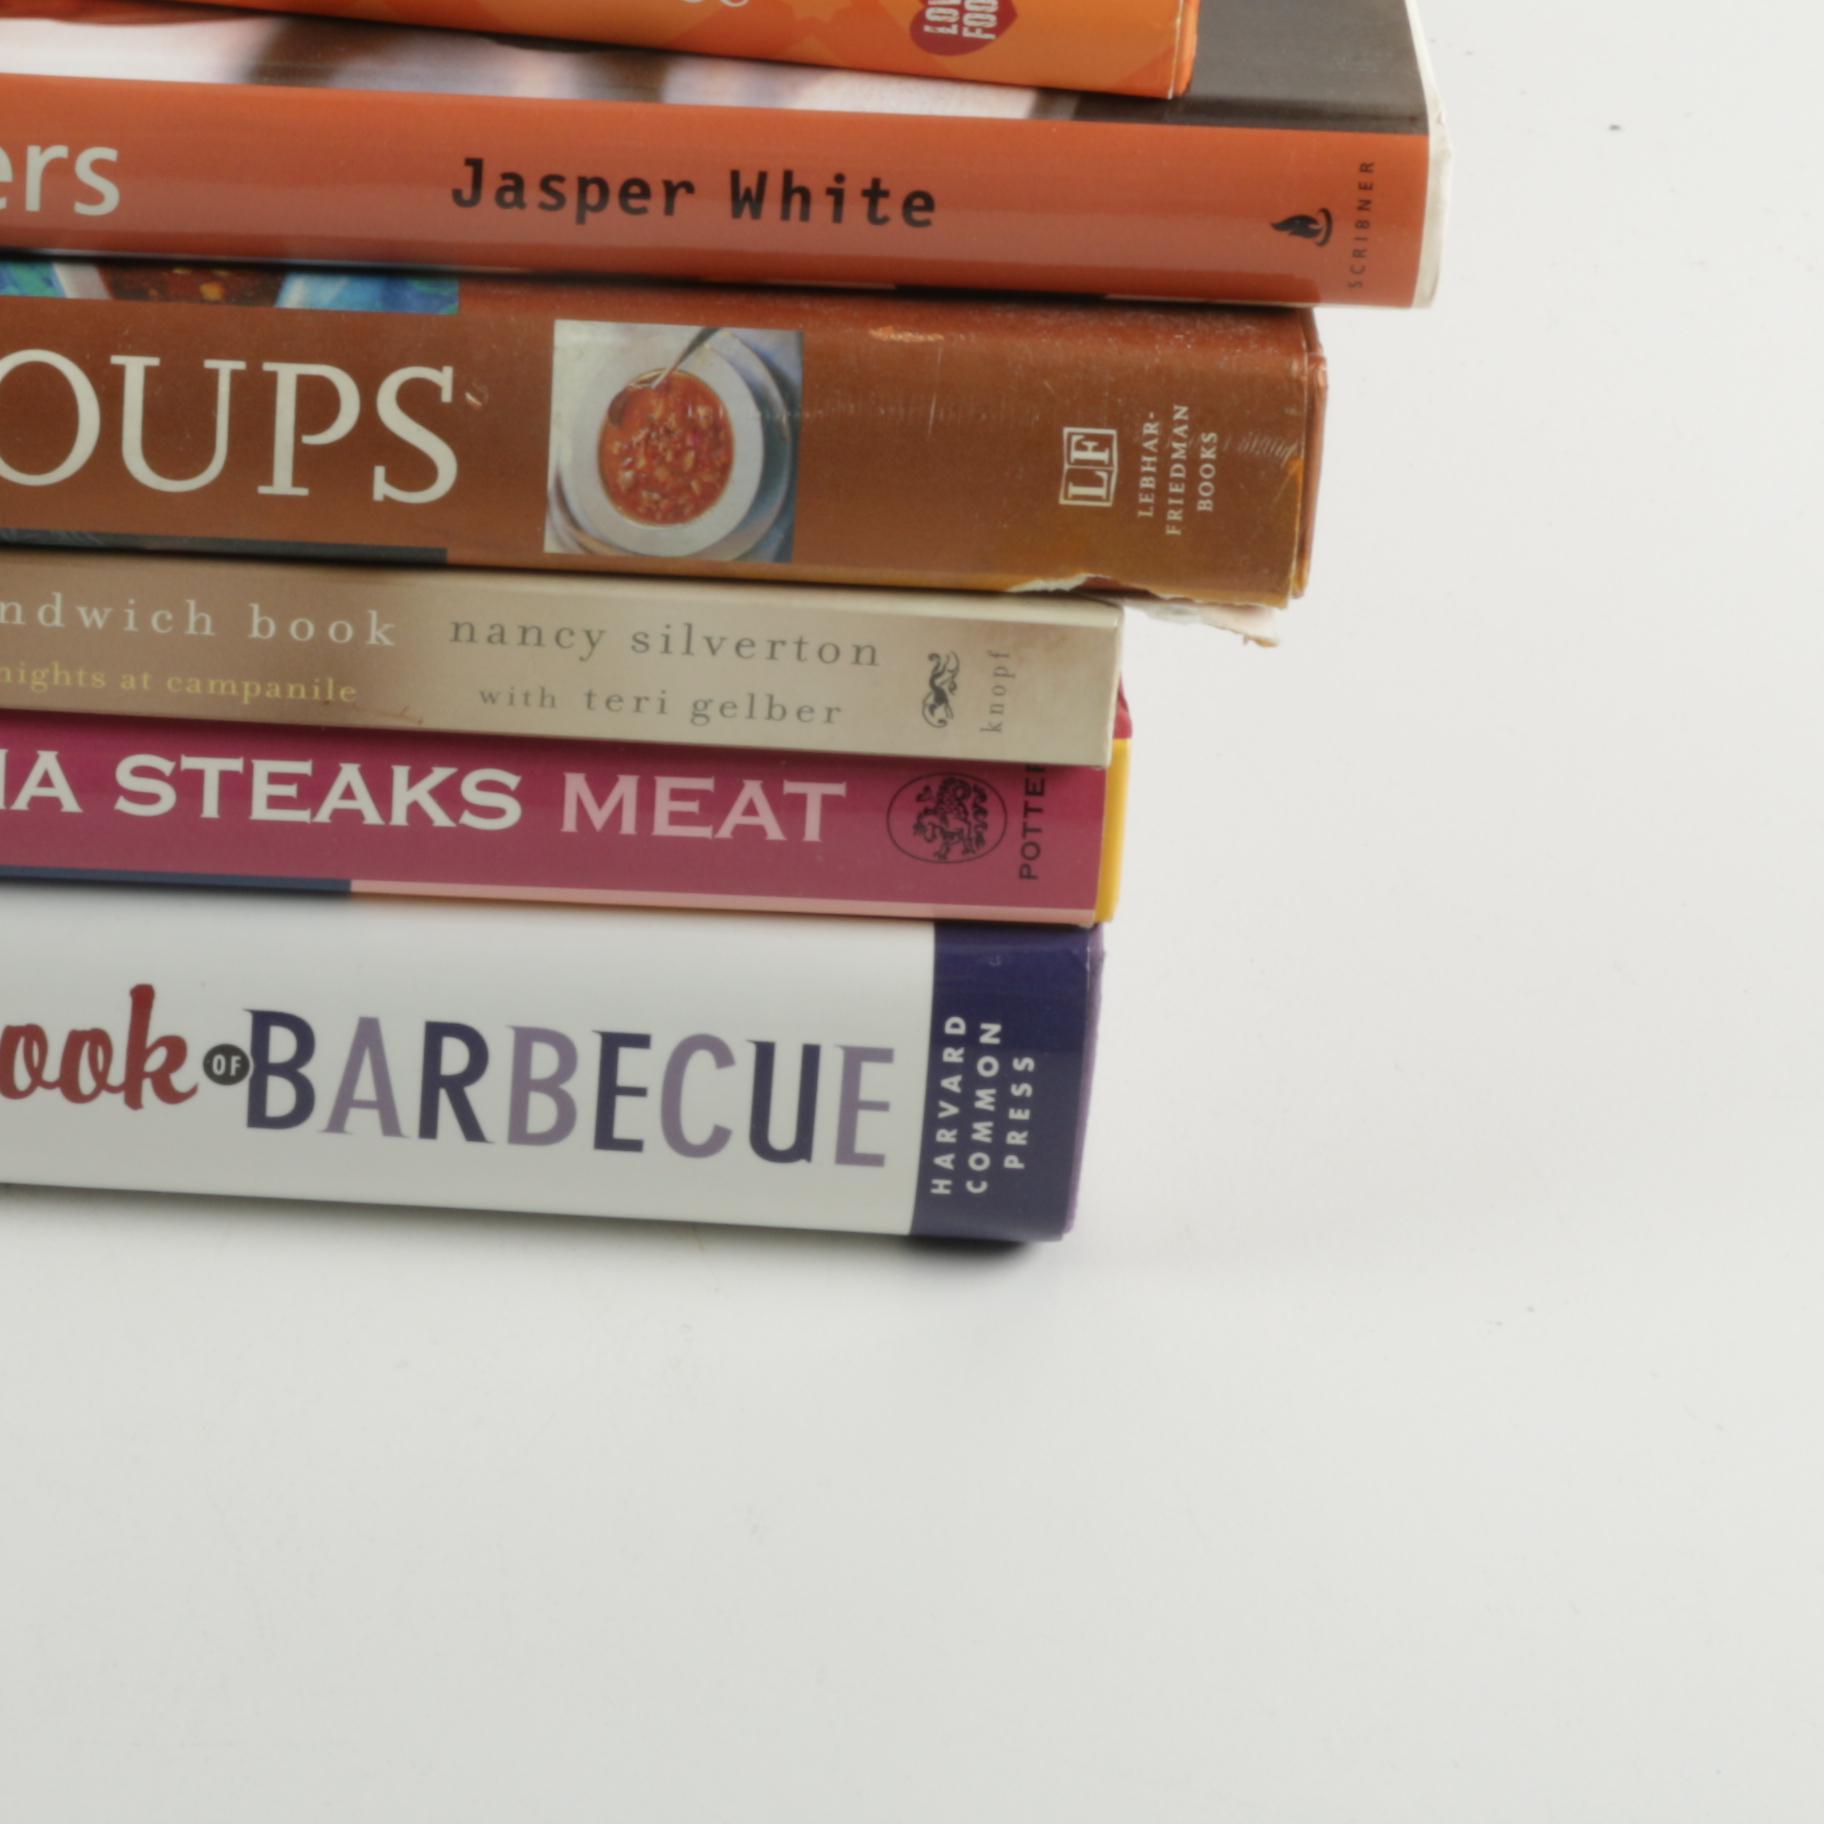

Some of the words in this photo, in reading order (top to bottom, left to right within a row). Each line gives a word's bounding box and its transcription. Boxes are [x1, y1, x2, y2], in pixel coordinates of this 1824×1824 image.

[451, 156, 696, 226] Jasper
[730, 169, 936, 228] White
[1347, 161, 1375, 289] SCRIBNER
[1067, 434, 1110, 500] LF
[1137, 411, 1161, 518] LEBHAR-
[1166, 404, 1190, 537] FRIEDMAN
[1196, 432, 1218, 512] BOOKS
[248, 603, 397, 647] book
[449, 619, 607, 663] nancy
[629, 623, 880, 668] silverton
[119, 668, 153, 692] at
[165, 675, 358, 705] campanile
[478, 685, 557, 711] with
[582, 686, 669, 716] teri
[689, 691, 844, 727] gelber
[979, 649, 1017, 734] knopf
[114, 752, 523, 832] STEAKS
[560, 770, 847, 843] MEAT
[211, 1053, 242, 1078] OF
[242, 1008, 897, 1169] BARBECUE
[930, 1015, 967, 1195] HARVARD
[965, 1022, 1003, 1194] COMMON
[1003, 1056, 1036, 1169] PRESS
